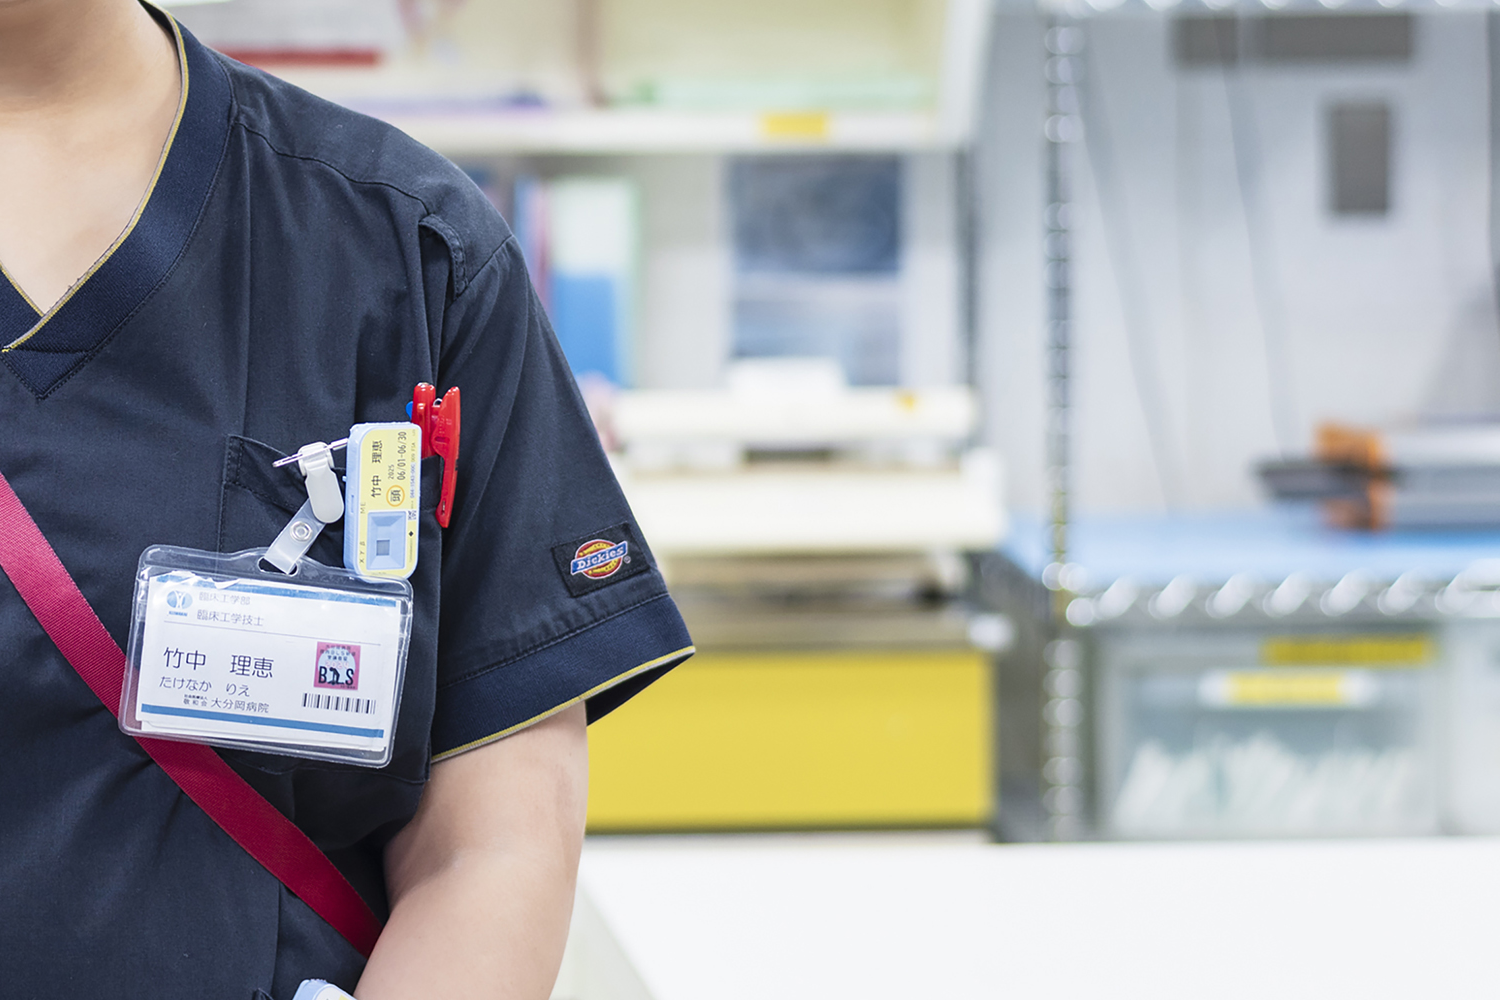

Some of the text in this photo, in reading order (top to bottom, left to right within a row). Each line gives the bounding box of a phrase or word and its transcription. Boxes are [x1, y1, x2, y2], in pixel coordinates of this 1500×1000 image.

[397, 431, 407, 481] 06/01-06/30
[371, 440, 383, 498] 竹中 理恵
[576, 546, 624, 570] Dickies
[199, 591, 251, 606] 臨床工学部
[196, 609, 264, 627] 臨床工学技士
[163, 646, 275, 679] 竹中 理恵
[159, 676, 250, 697] たけなか りえ
[211, 697, 270, 714] 大分岡病院
